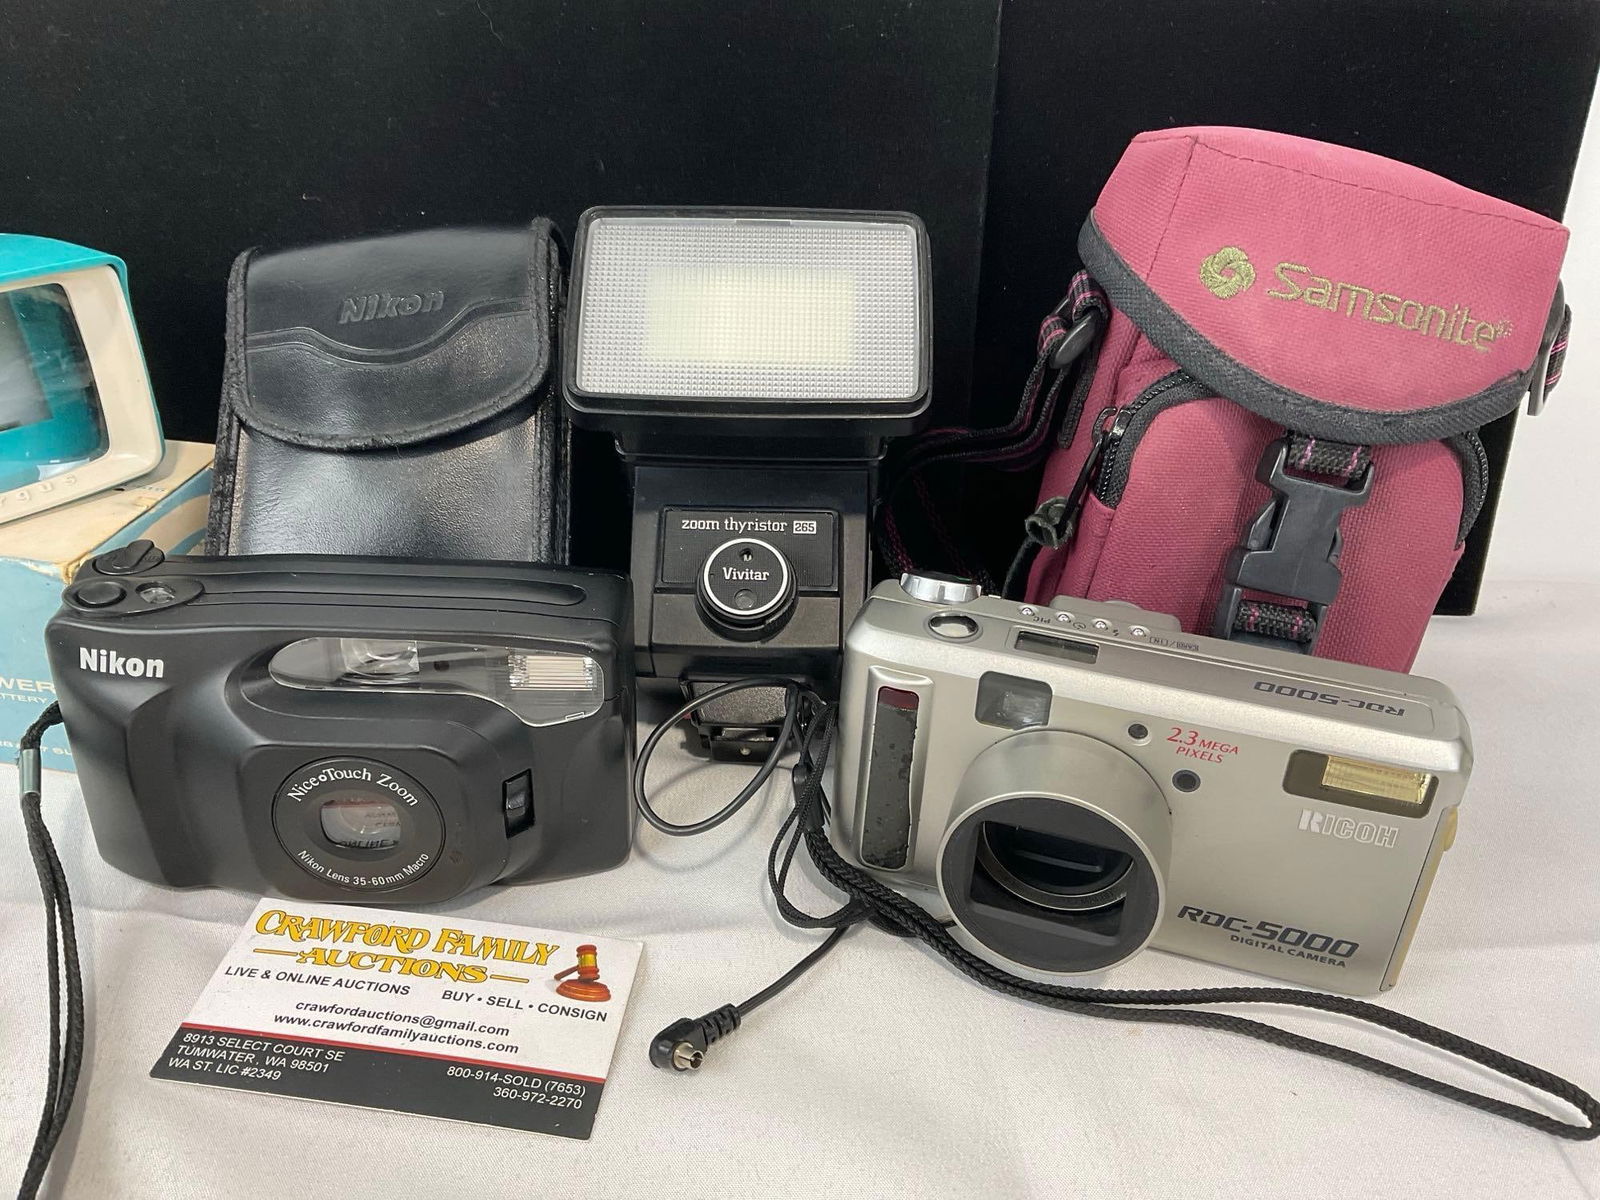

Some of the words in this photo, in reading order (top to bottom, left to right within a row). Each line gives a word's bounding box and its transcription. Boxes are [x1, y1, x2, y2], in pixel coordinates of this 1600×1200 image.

[338, 290, 445, 325] Nikon
[1266, 262, 1497, 352] Samsonite
[681, 519, 720, 531] zoom
[724, 517, 788, 534] thyristor
[793, 521, 817, 534] 265
[722, 567, 770, 581] Vivitar
[79, 647, 164, 679] Nikon
[1253, 681, 1405, 717] RDC-5000
[1166, 727, 1200, 746] 2.3
[1199, 739, 1240, 755] MEGA
[1175, 745, 1224, 764] PIXELS
[376, 773, 418, 807] Zoom
[1299, 808, 1399, 848] RICOH
[298, 850, 324, 873] Nikon
[326, 869, 351, 884] Lens
[353, 871, 405, 886] 35-60mm
[402, 852, 429, 876] Macro
[255, 909, 431, 954] CRAWFORD
[432, 928, 560, 967] FAMILY
[1177, 905, 1360, 959] RDC-5000
[296, 947, 488, 984] AUCTIONS
[1230, 934, 1284, 954] DIGITAL
[1287, 948, 1346, 968] CAMERA
[225, 966, 259, 978] LIVE
[261, 969, 271, 979] &
[275, 971, 332, 987] ONLINE
[332, 979, 411, 996] AUCTIONS
[295, 1002, 510, 1037] crawfordauctions@gmail.com
[441, 989, 475, 1003] BUY
[486, 996, 524, 1010] SELL
[537, 1002, 608, 1023] CONSIGN
[183, 1033, 215, 1046] 8913
[216, 1037, 272, 1052] SELECT
[272, 1043, 324, 1059] COURT
[324, 1050, 346, 1063] SE
[274, 1014, 519, 1054] www.crawfordfamilyauctions.com
[168, 1057, 191, 1069] WA
[192, 1060, 212, 1072] ST.
[215, 1064, 241, 1076] LIC
[240, 1066, 282, 1081] #2349
[264, 1055, 288, 1068] WA
[290, 1059, 330, 1073] 98501
[446, 1066, 542, 1090] 800-914-SOLD
[543, 1080, 587, 1098] (7653)
[493, 1086, 583, 1110] 360-972-2270
